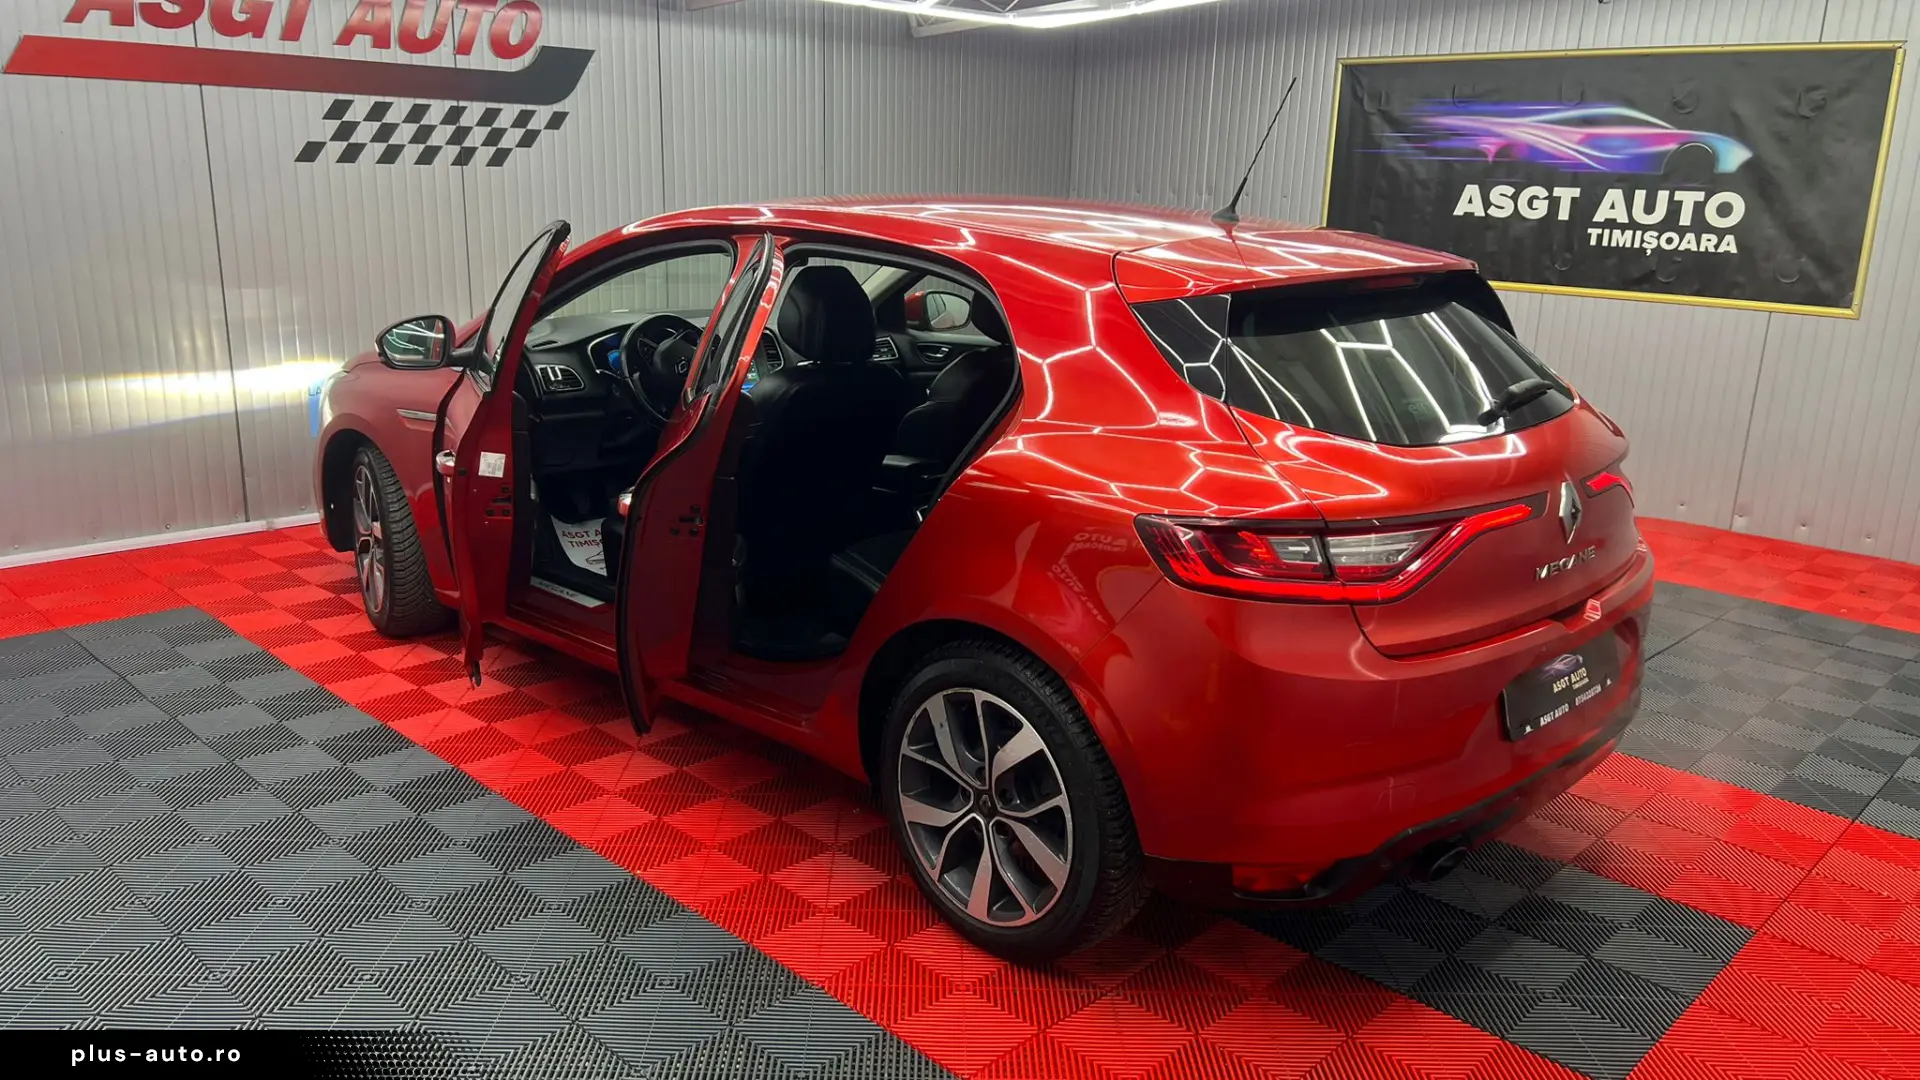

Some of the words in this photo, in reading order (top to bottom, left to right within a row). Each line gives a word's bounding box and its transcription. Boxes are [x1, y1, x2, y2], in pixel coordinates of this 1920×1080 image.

[334, 0, 543, 60] AUTO
[1453, 184, 1581, 221] ASGT
[1592, 188, 1746, 228] AUTO
[1587, 228, 1738, 256] TIMIȘOARA
[562, 530, 590, 539] ASGT
[1535, 545, 1596, 581] MEGANE
[1552, 676, 1570, 693] ASGT
[1570, 667, 1587, 683] AUTO
[1540, 712, 1555, 726] ASGT
[1554, 703, 1570, 719] AUTO
